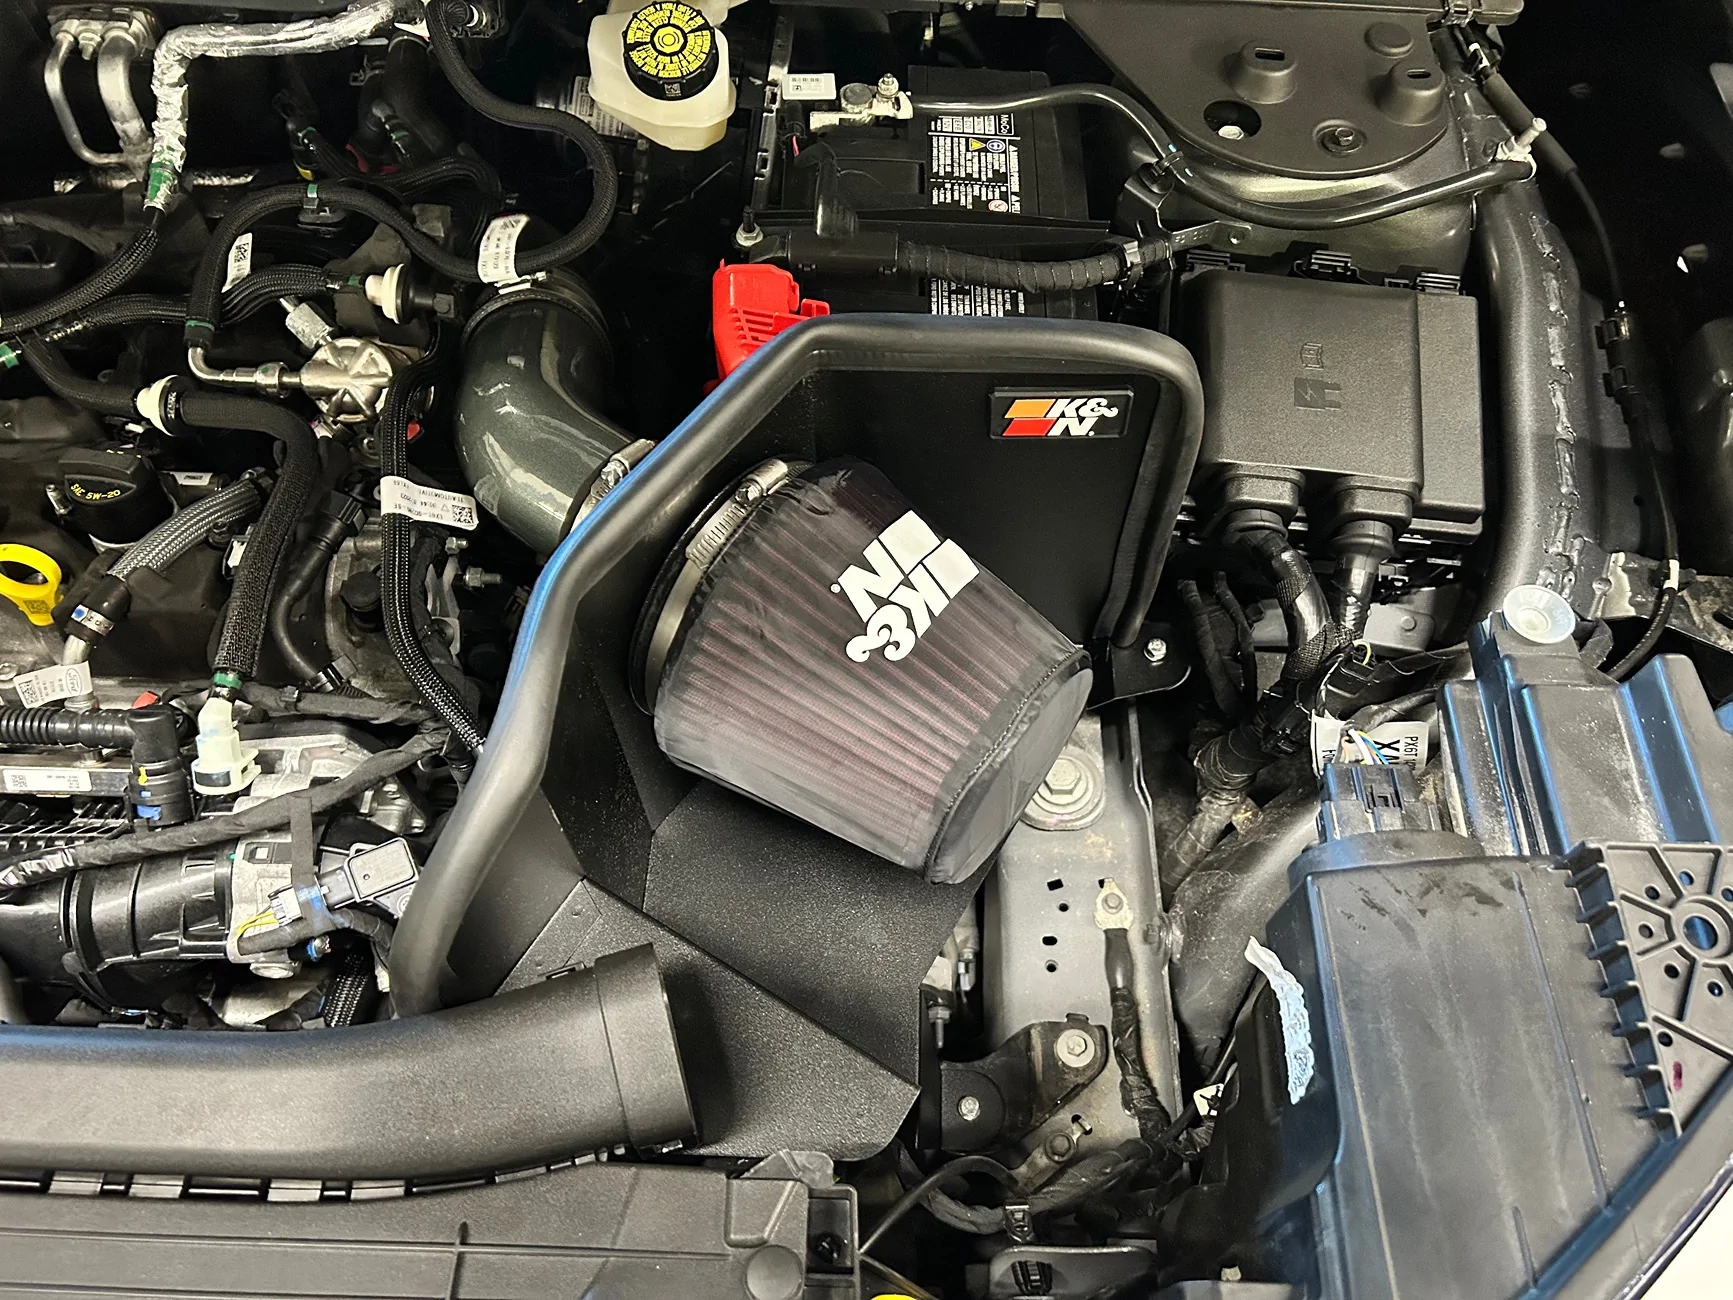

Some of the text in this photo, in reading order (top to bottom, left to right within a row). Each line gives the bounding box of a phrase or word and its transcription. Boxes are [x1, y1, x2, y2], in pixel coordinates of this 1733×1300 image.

[70, 483, 121, 501] SAE 5W-20
[1403, 736, 1419, 757] PX6T
